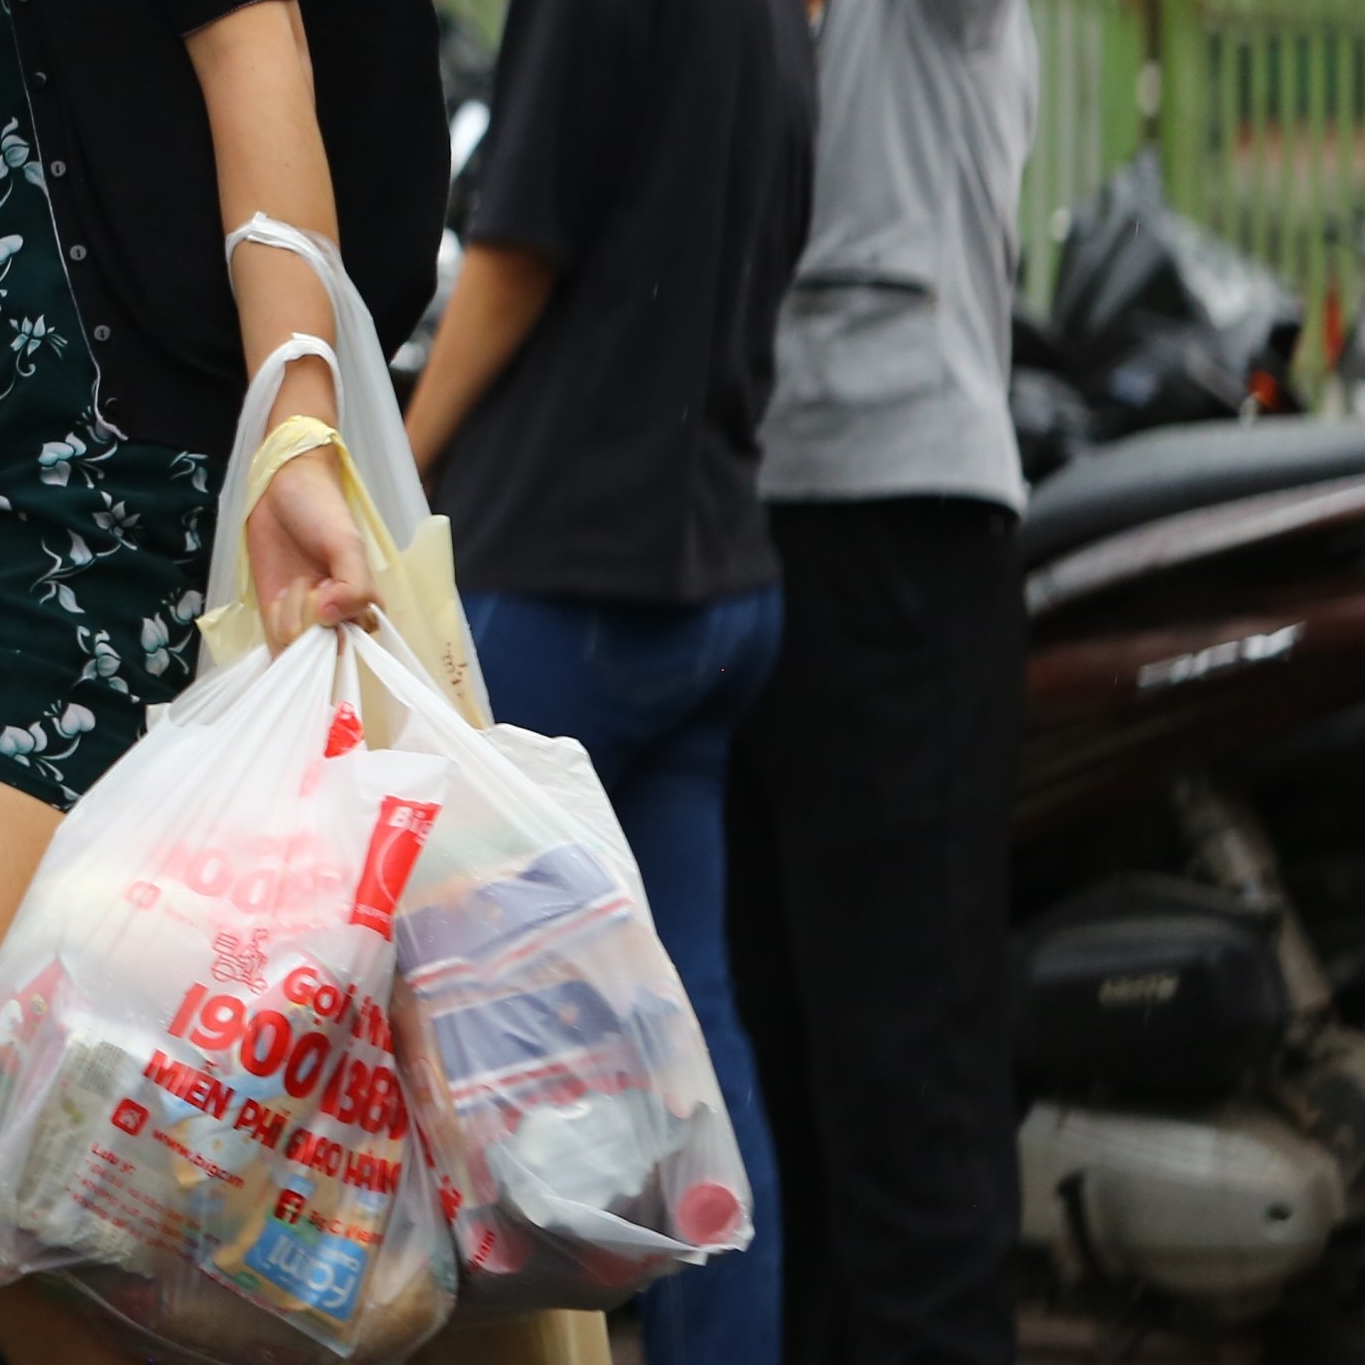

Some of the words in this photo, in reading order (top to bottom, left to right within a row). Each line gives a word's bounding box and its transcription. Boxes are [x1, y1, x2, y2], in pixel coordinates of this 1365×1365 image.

[283, 966, 357, 1025] Gọi
[168, 982, 331, 1100] 1900
[143, 1049, 237, 1121] MIỄN
